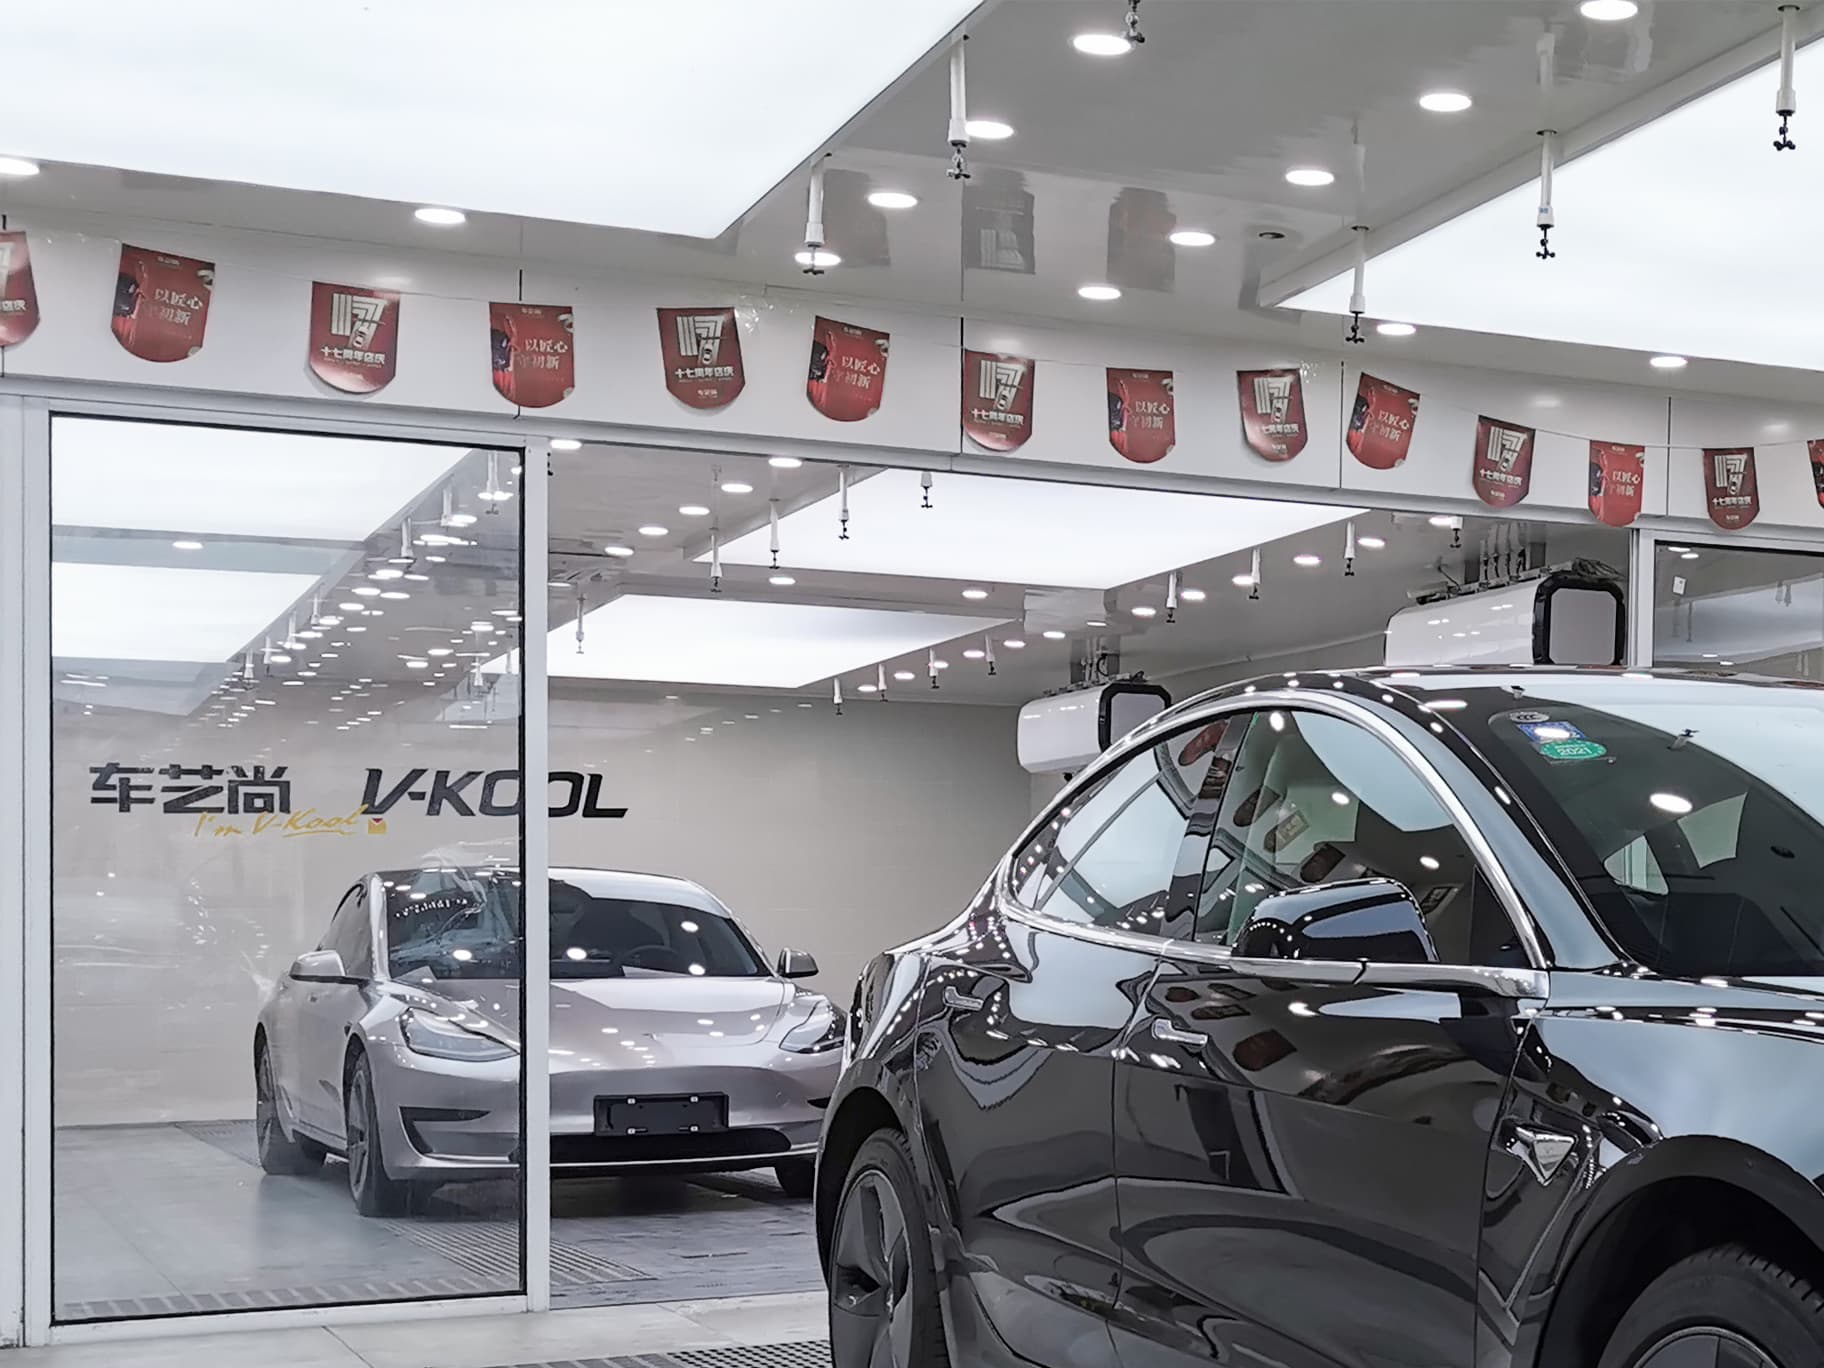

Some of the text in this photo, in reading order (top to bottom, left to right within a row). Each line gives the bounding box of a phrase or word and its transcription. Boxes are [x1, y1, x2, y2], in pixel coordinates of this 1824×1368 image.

[155, 288, 203, 310] 以匠心
[525, 338, 568, 352] 以匠心
[675, 366, 734, 378] 十七周年店庆
[1556, 746, 1593, 756] 2021
[90, 762, 291, 814] 车艺尚
[360, 768, 629, 818] V-KOOL
